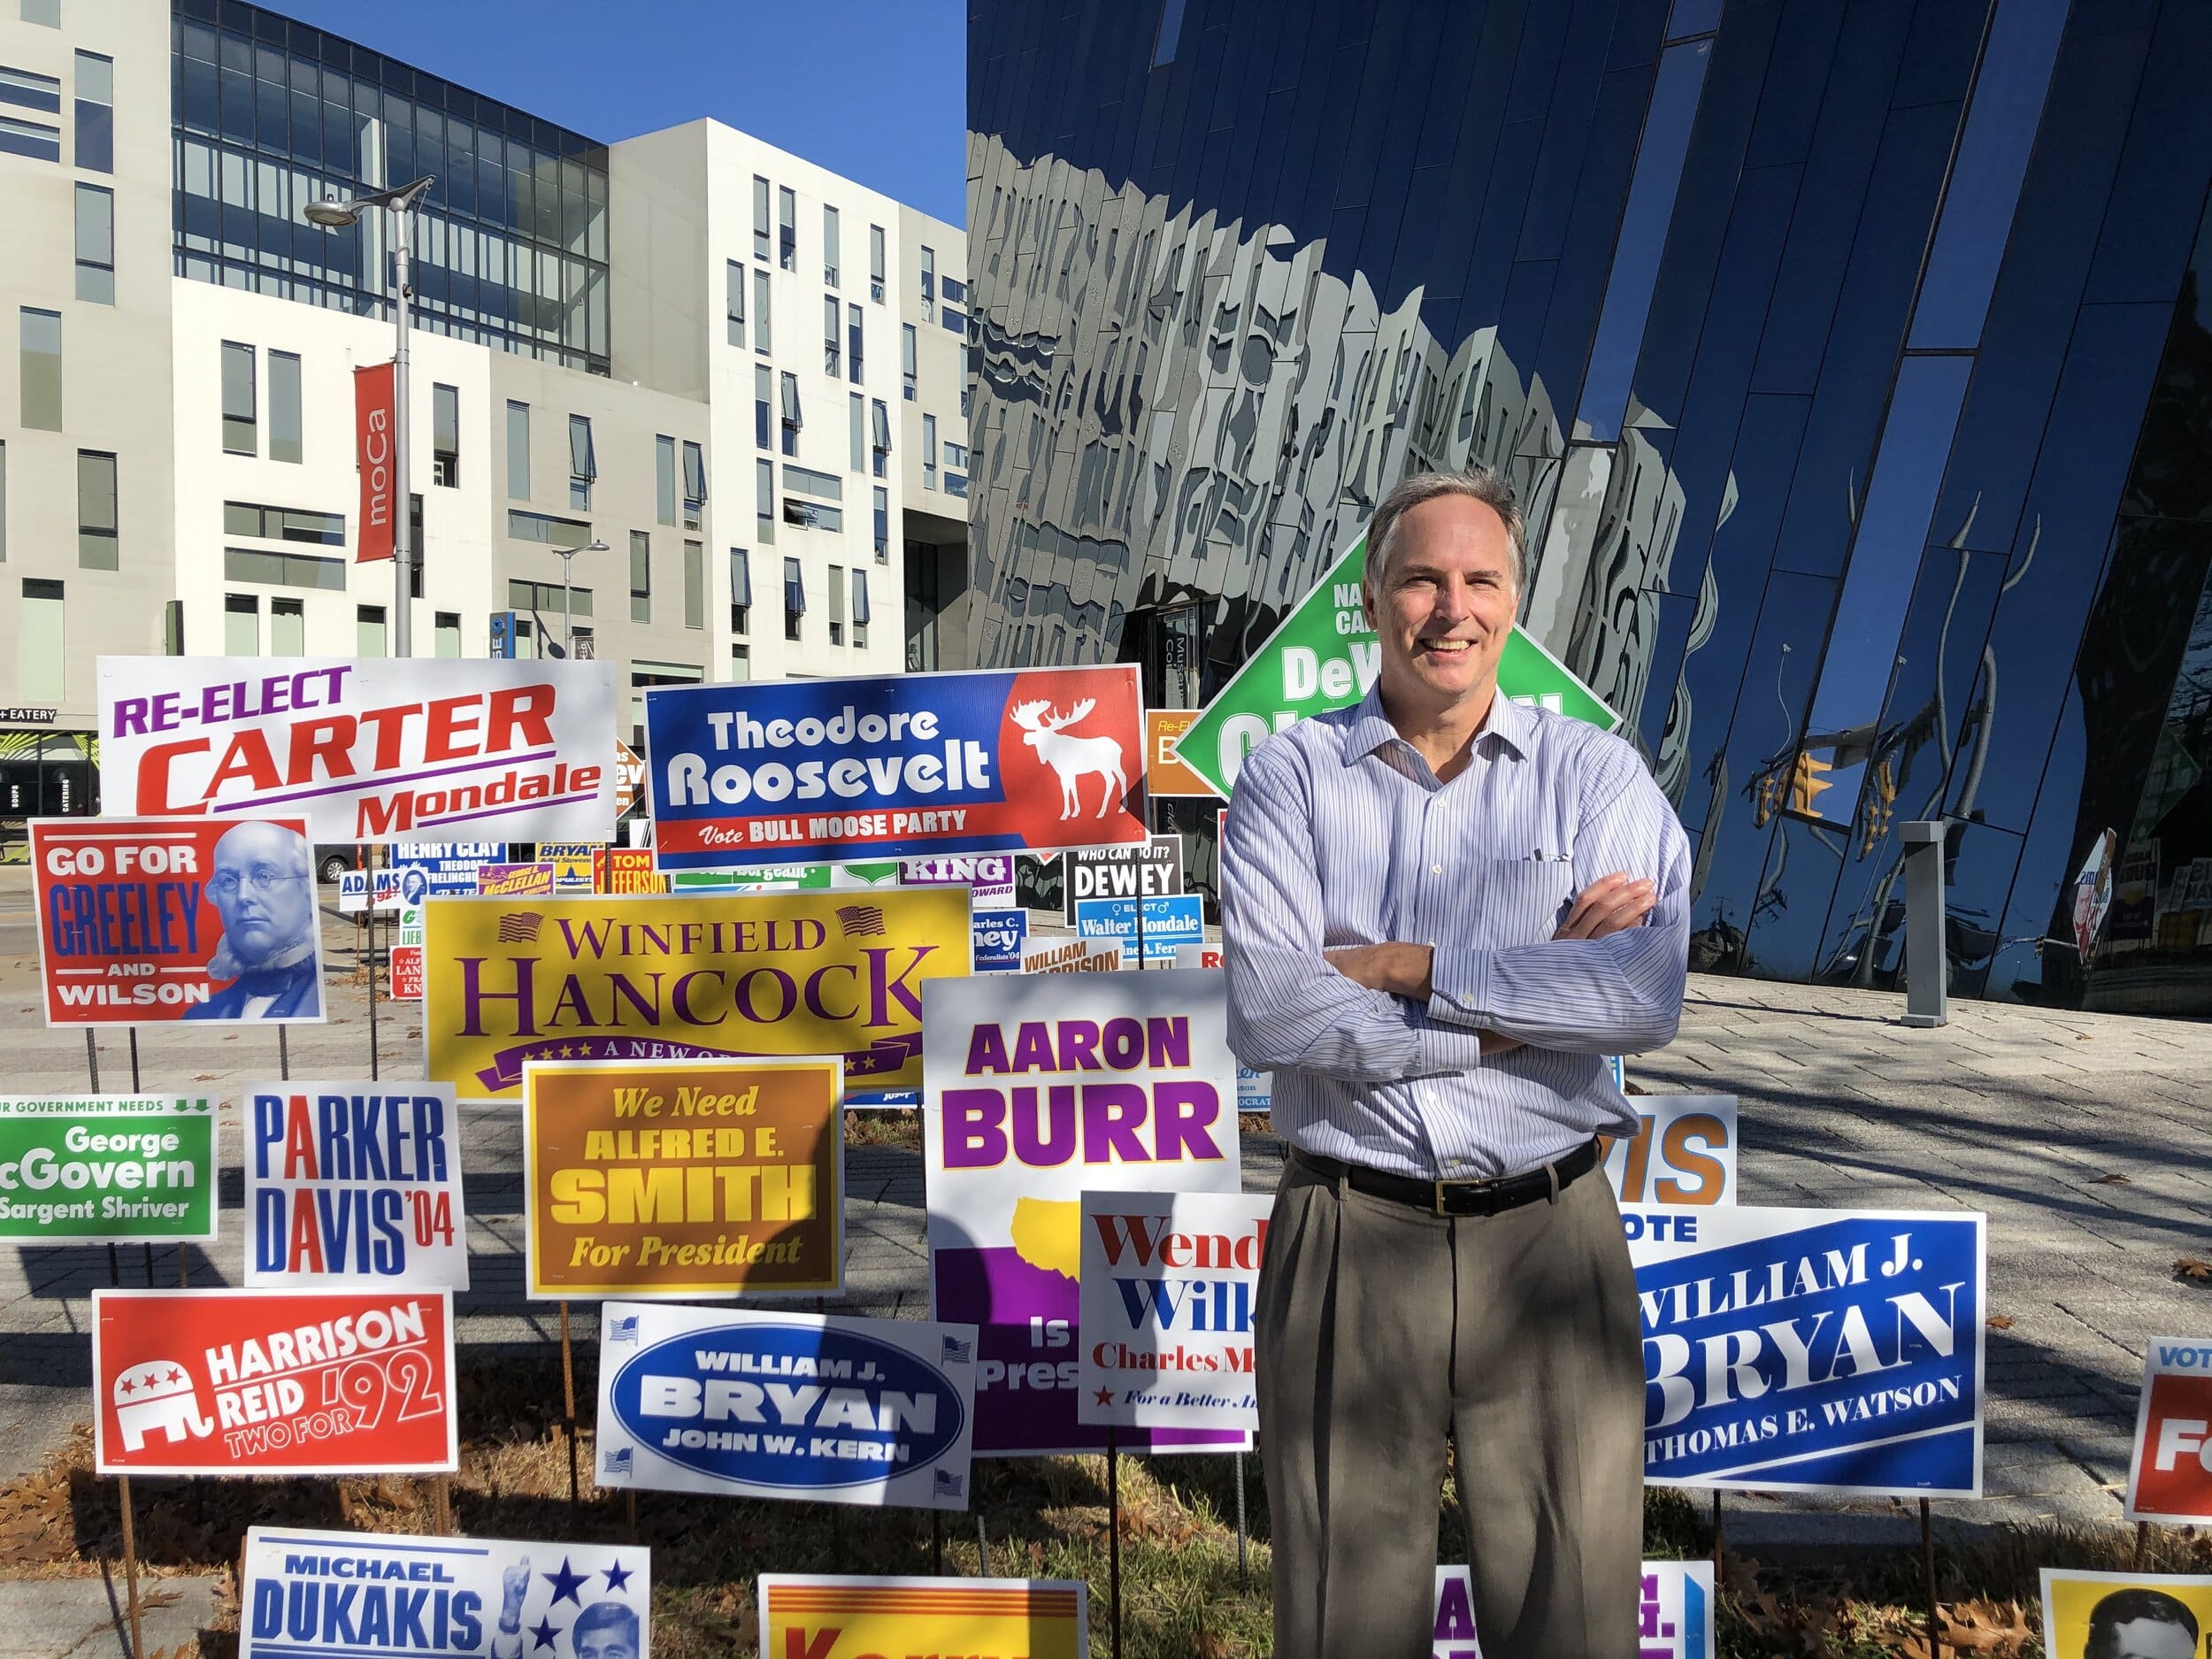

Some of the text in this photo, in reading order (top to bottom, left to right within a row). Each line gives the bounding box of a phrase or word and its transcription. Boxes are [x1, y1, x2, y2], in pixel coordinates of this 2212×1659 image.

[369, 408, 387, 526] moCa
[10, 710, 56, 720] EATERY
[113, 665, 351, 738] RE-ELECT
[708, 705, 939, 751] Theodore
[136, 684, 557, 816] CARTER
[667, 739, 990, 806] Roosevelt
[357, 762, 603, 839] Mondale
[699, 810, 967, 845] Vote BULL MOOSE PARTY
[47, 845, 198, 876] GO FOR
[398, 842, 501, 859] HENRY CLAY
[613, 855, 650, 868] TOM
[1078, 846, 1170, 861] WHO CAN O IT?
[342, 872, 400, 893] ADAMS
[597, 870, 666, 894] JFFERSON
[905, 857, 1006, 881] KING
[1074, 864, 1175, 896] DEWEY
[49, 881, 200, 957] GREELEY
[1006, 918, 1019, 927] C.
[1124, 903, 1156, 912] ELCT
[554, 917, 826, 959] WINFIELD
[1081, 918, 1132, 936] Walter
[108, 963, 156, 977] AND
[1025, 941, 1087, 972] WILLIAM
[56, 982, 210, 1006] WILSON
[454, 945, 941, 1038] HANCOCK
[603, 1041, 618, 1056] A
[630, 1041, 692, 1059] NEW
[965, 1017, 1193, 1077] AARON
[16, 1101, 113, 1112] GOVERNMENT
[119, 1100, 164, 1111] NEEDS
[613, 1086, 760, 1118] We Need
[65, 1125, 180, 1158] George
[254, 1094, 448, 1182] PARKER
[585, 1127, 784, 1160] ALFRED E.
[941, 1083, 1225, 1171] BURR
[0, 1196, 189, 1225] Sargent Shriver
[550, 1164, 817, 1224] SMITH
[255, 1187, 406, 1276] DAVIS
[569, 1234, 804, 1267] For President
[1882, 1233, 1924, 1279] J.
[205, 1302, 426, 1386] HARRISON
[1030, 1317, 1071, 1348] Is
[695, 1350, 886, 1382] WILLIAM J.
[1093, 1342, 1217, 1371] Charles
[1643, 1281, 1966, 1432] BRYAN
[215, 1379, 304, 1430] REID
[640, 1375, 938, 1435] BRYAN
[1125, 1390, 1157, 1405] For
[1160, 1395, 1171, 1406] a
[1175, 1391, 1231, 1408] Better
[224, 1406, 356, 1459] TWO FOR
[1643, 1376, 1962, 1464] THOMAS E. WATSON
[662, 1428, 910, 1463] JOHN W. KERN
[284, 1554, 455, 1584] MICHAEL
[251, 1578, 482, 1651] DUKAKIS
